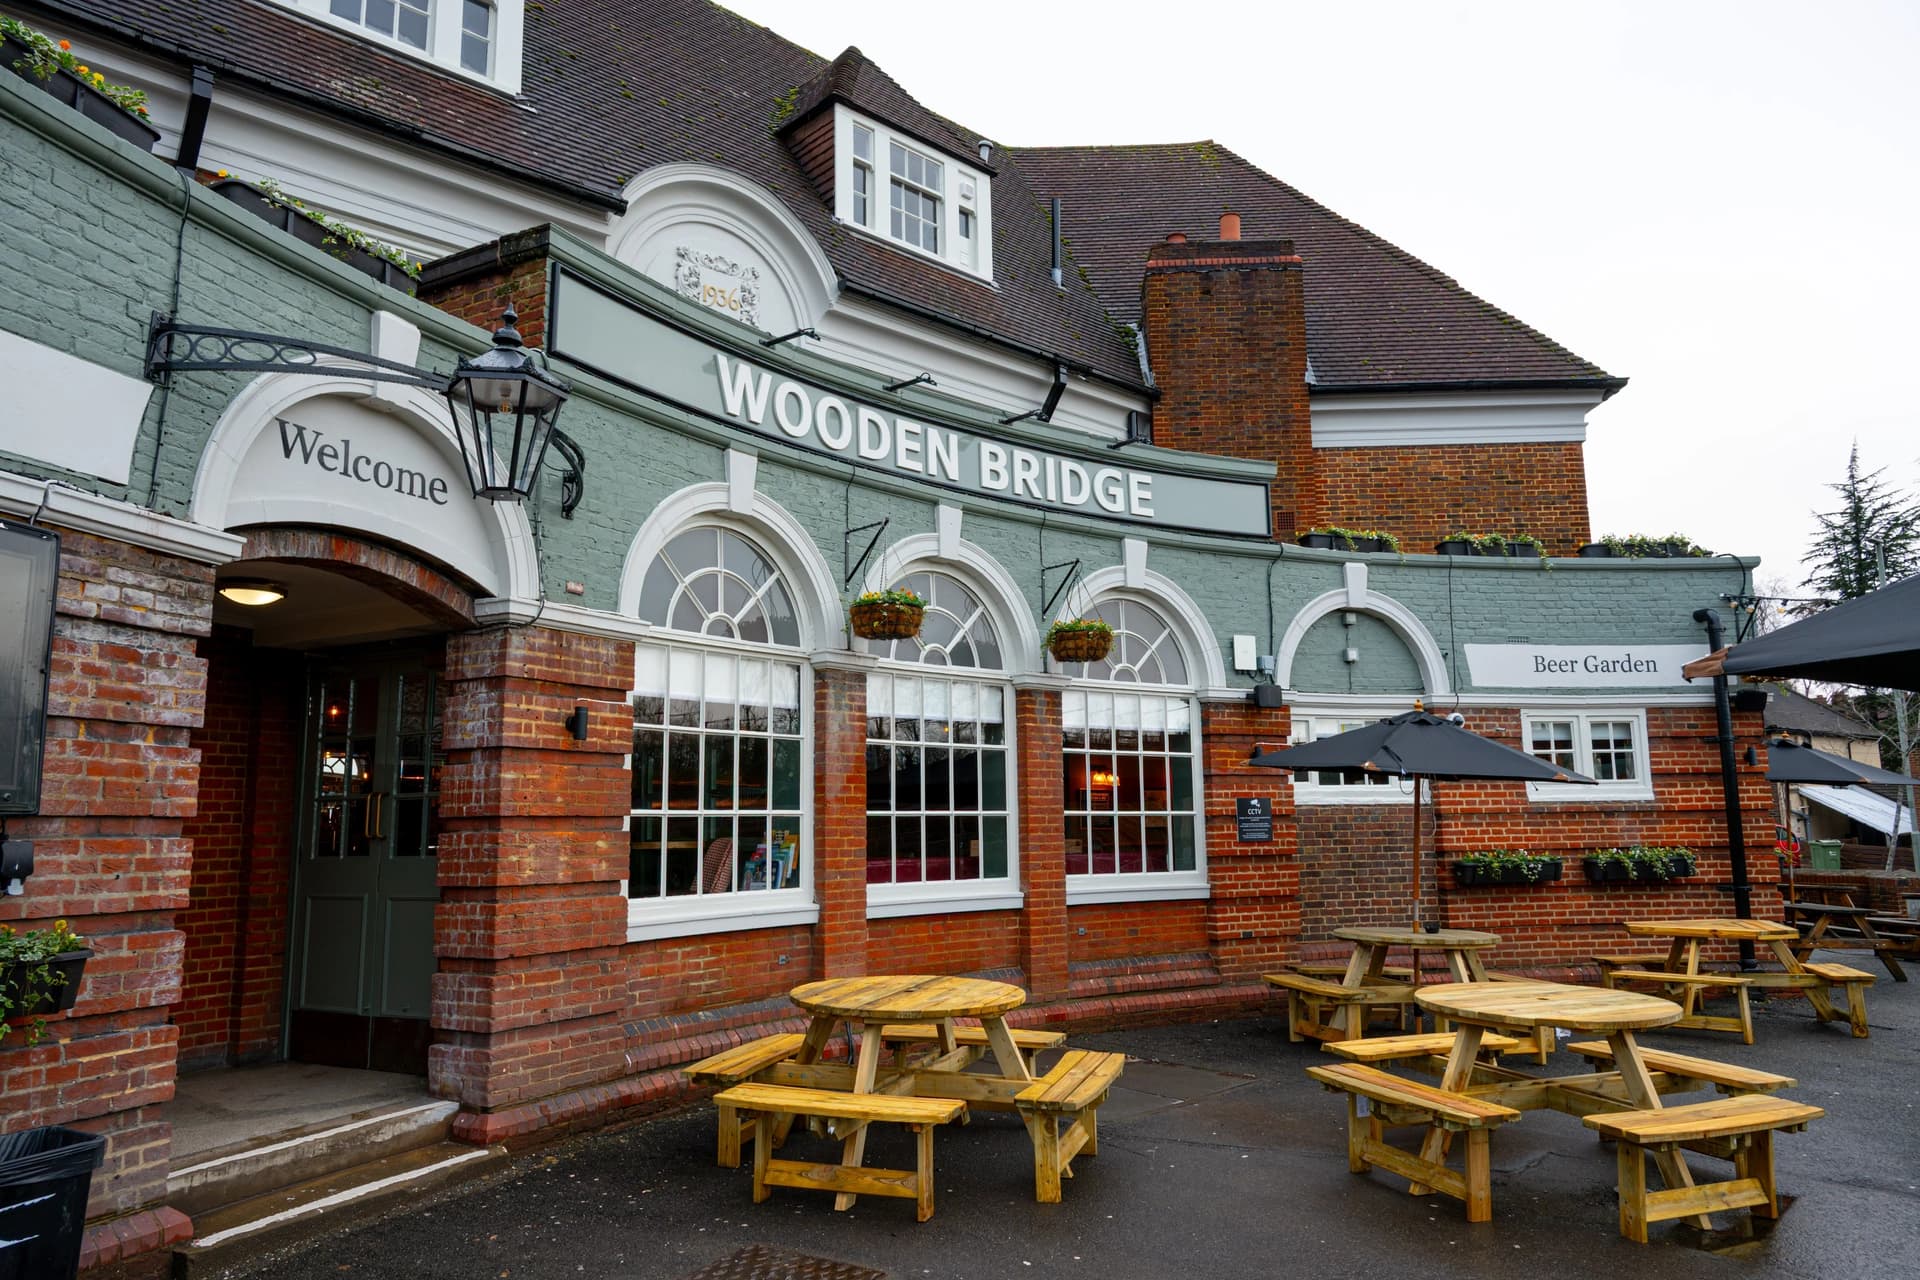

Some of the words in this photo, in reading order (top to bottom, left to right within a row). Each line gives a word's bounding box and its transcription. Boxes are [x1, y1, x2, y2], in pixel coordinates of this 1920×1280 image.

[703, 284, 740, 311] 1936
[275, 417, 448, 505] Welcome
[714, 353, 960, 482] WOODEN
[979, 440, 1155, 518] BRIDGE
[1532, 655, 1578, 673] Beer
[1583, 653, 1658, 674] Garden
